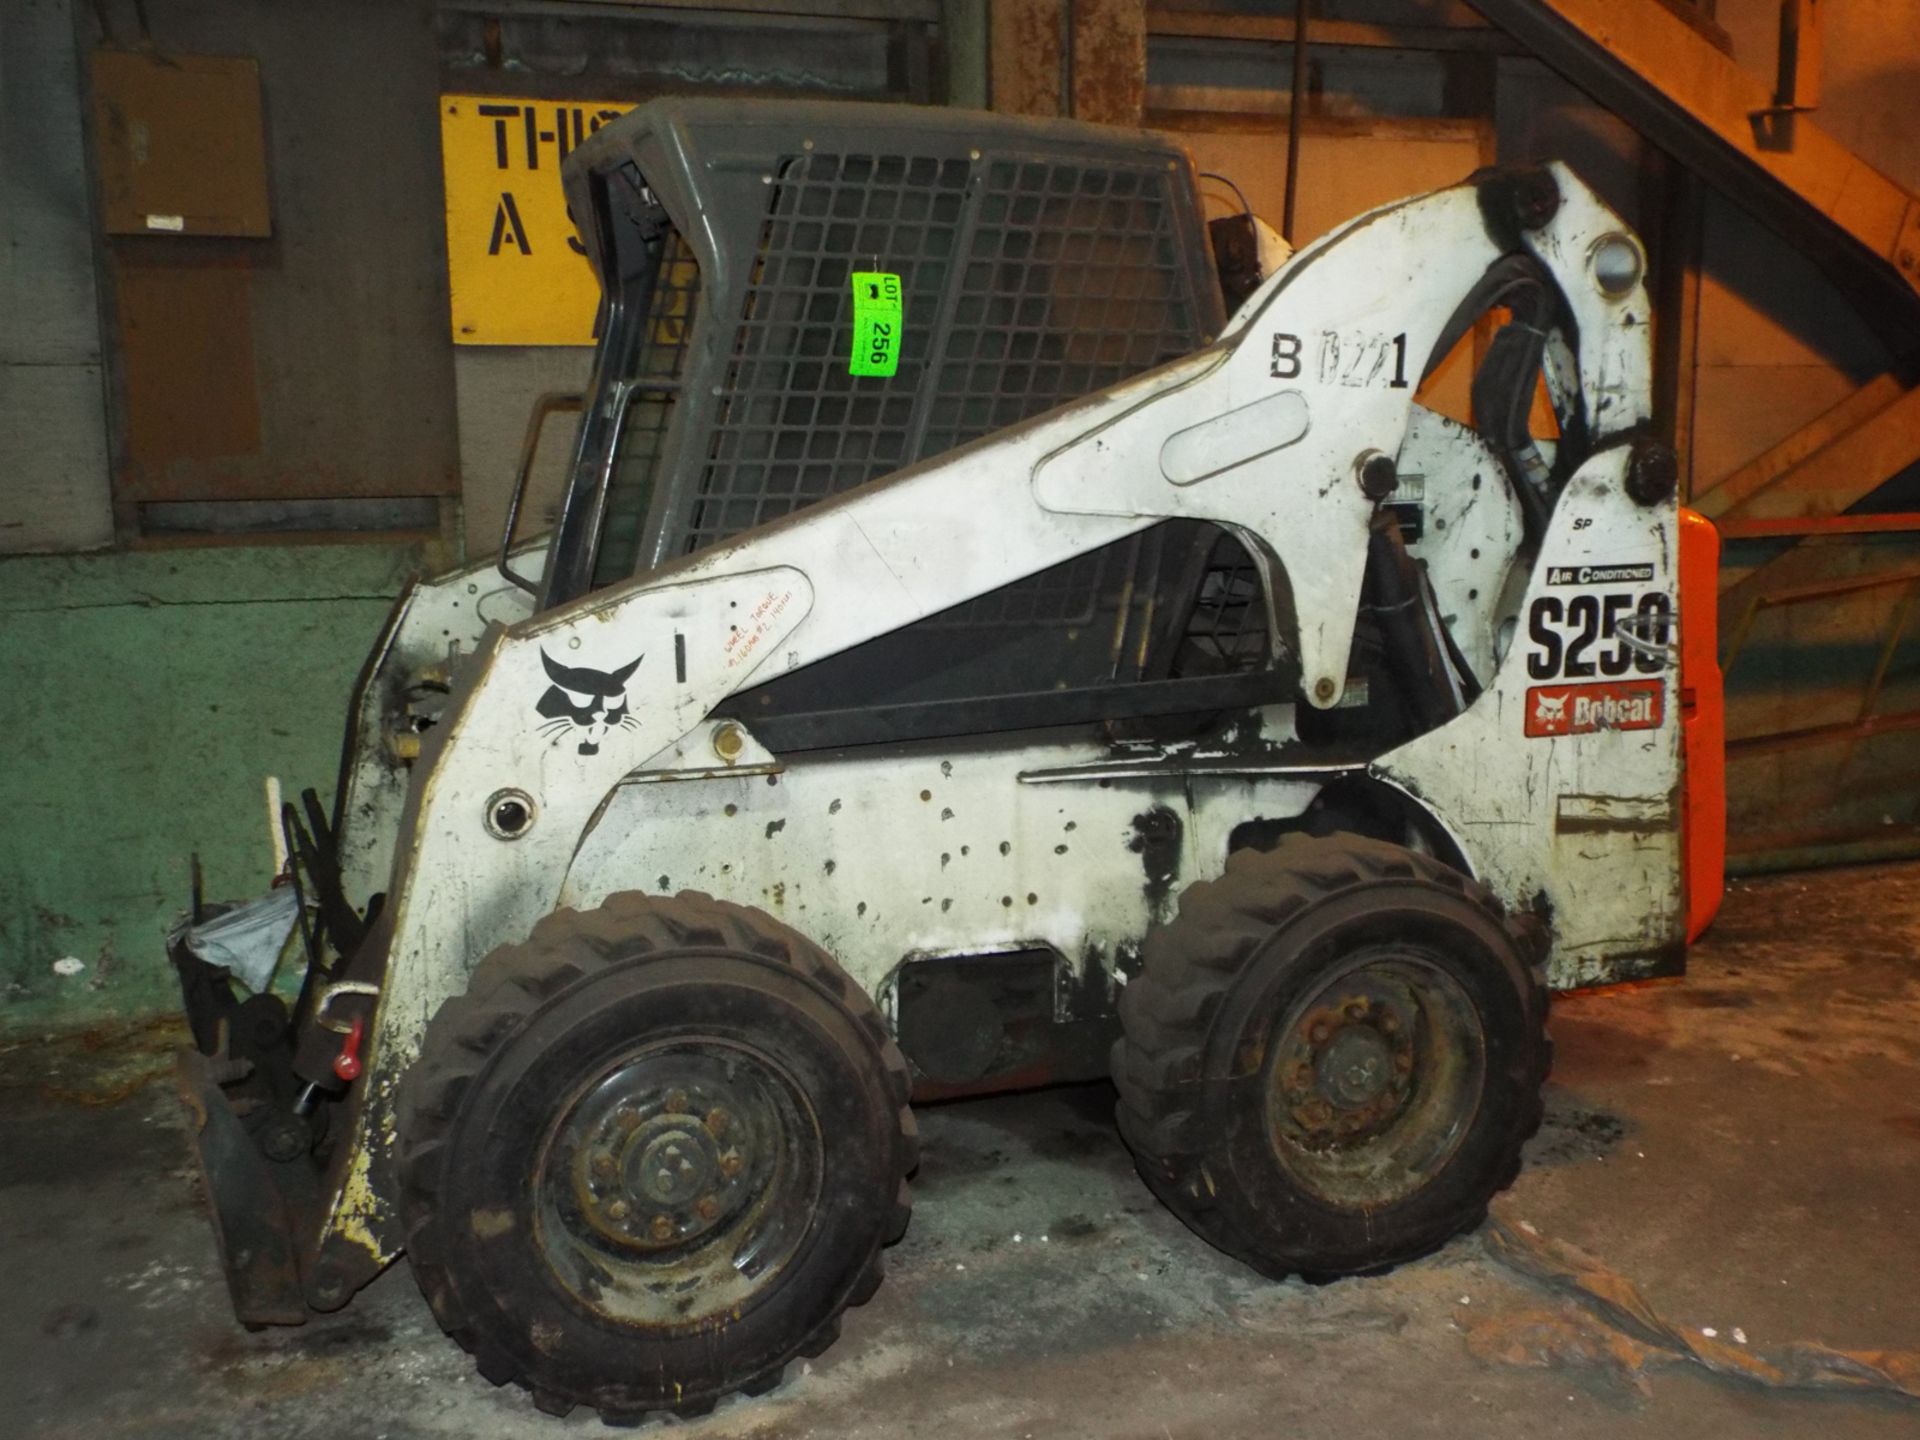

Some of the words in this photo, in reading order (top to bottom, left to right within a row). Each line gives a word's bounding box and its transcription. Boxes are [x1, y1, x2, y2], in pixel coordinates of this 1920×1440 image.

[488, 192, 533, 256] A
[870, 322, 892, 364] 256
[1572, 518, 1593, 531] SP
[1527, 591, 1671, 681] S250
[1573, 696, 1653, 725] Bobcat
